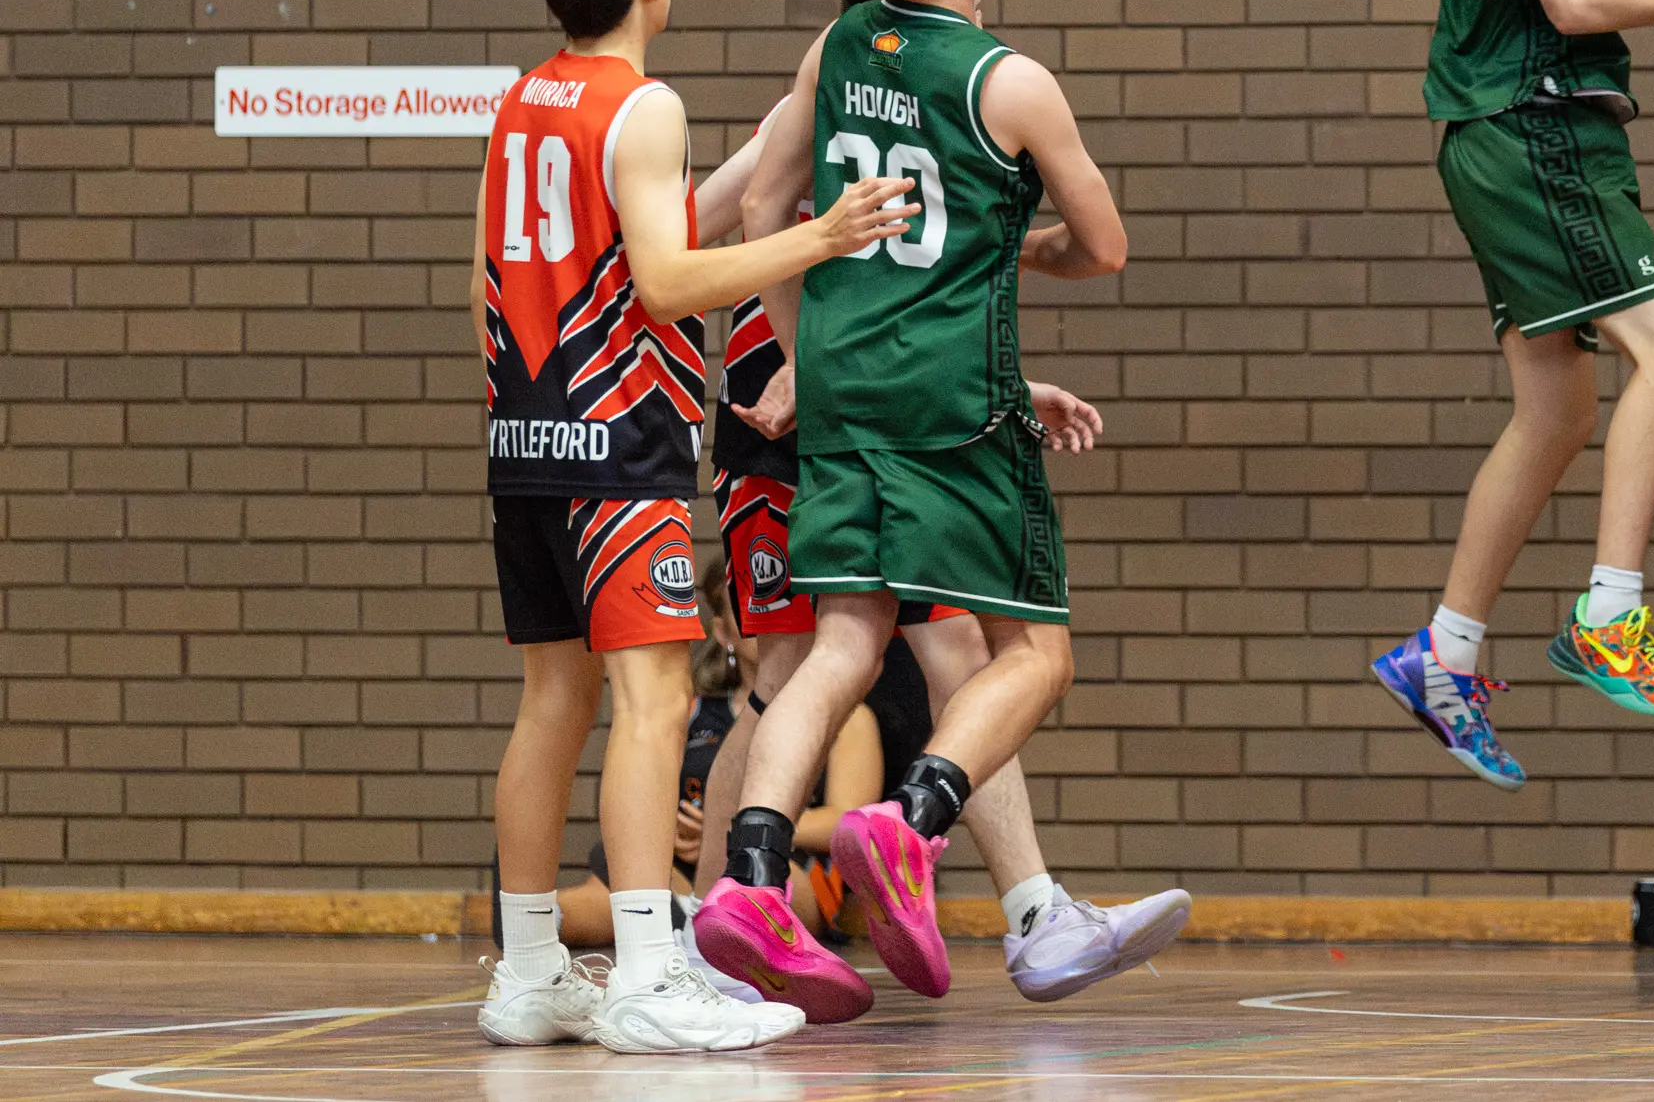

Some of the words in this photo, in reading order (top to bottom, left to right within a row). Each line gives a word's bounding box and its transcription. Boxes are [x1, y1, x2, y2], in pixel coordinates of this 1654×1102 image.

[229, 88, 267, 116] No
[275, 87, 387, 122] Storage
[520, 76, 588, 109] MURACA
[845, 81, 921, 129] HOUGH
[503, 132, 575, 263] 19
